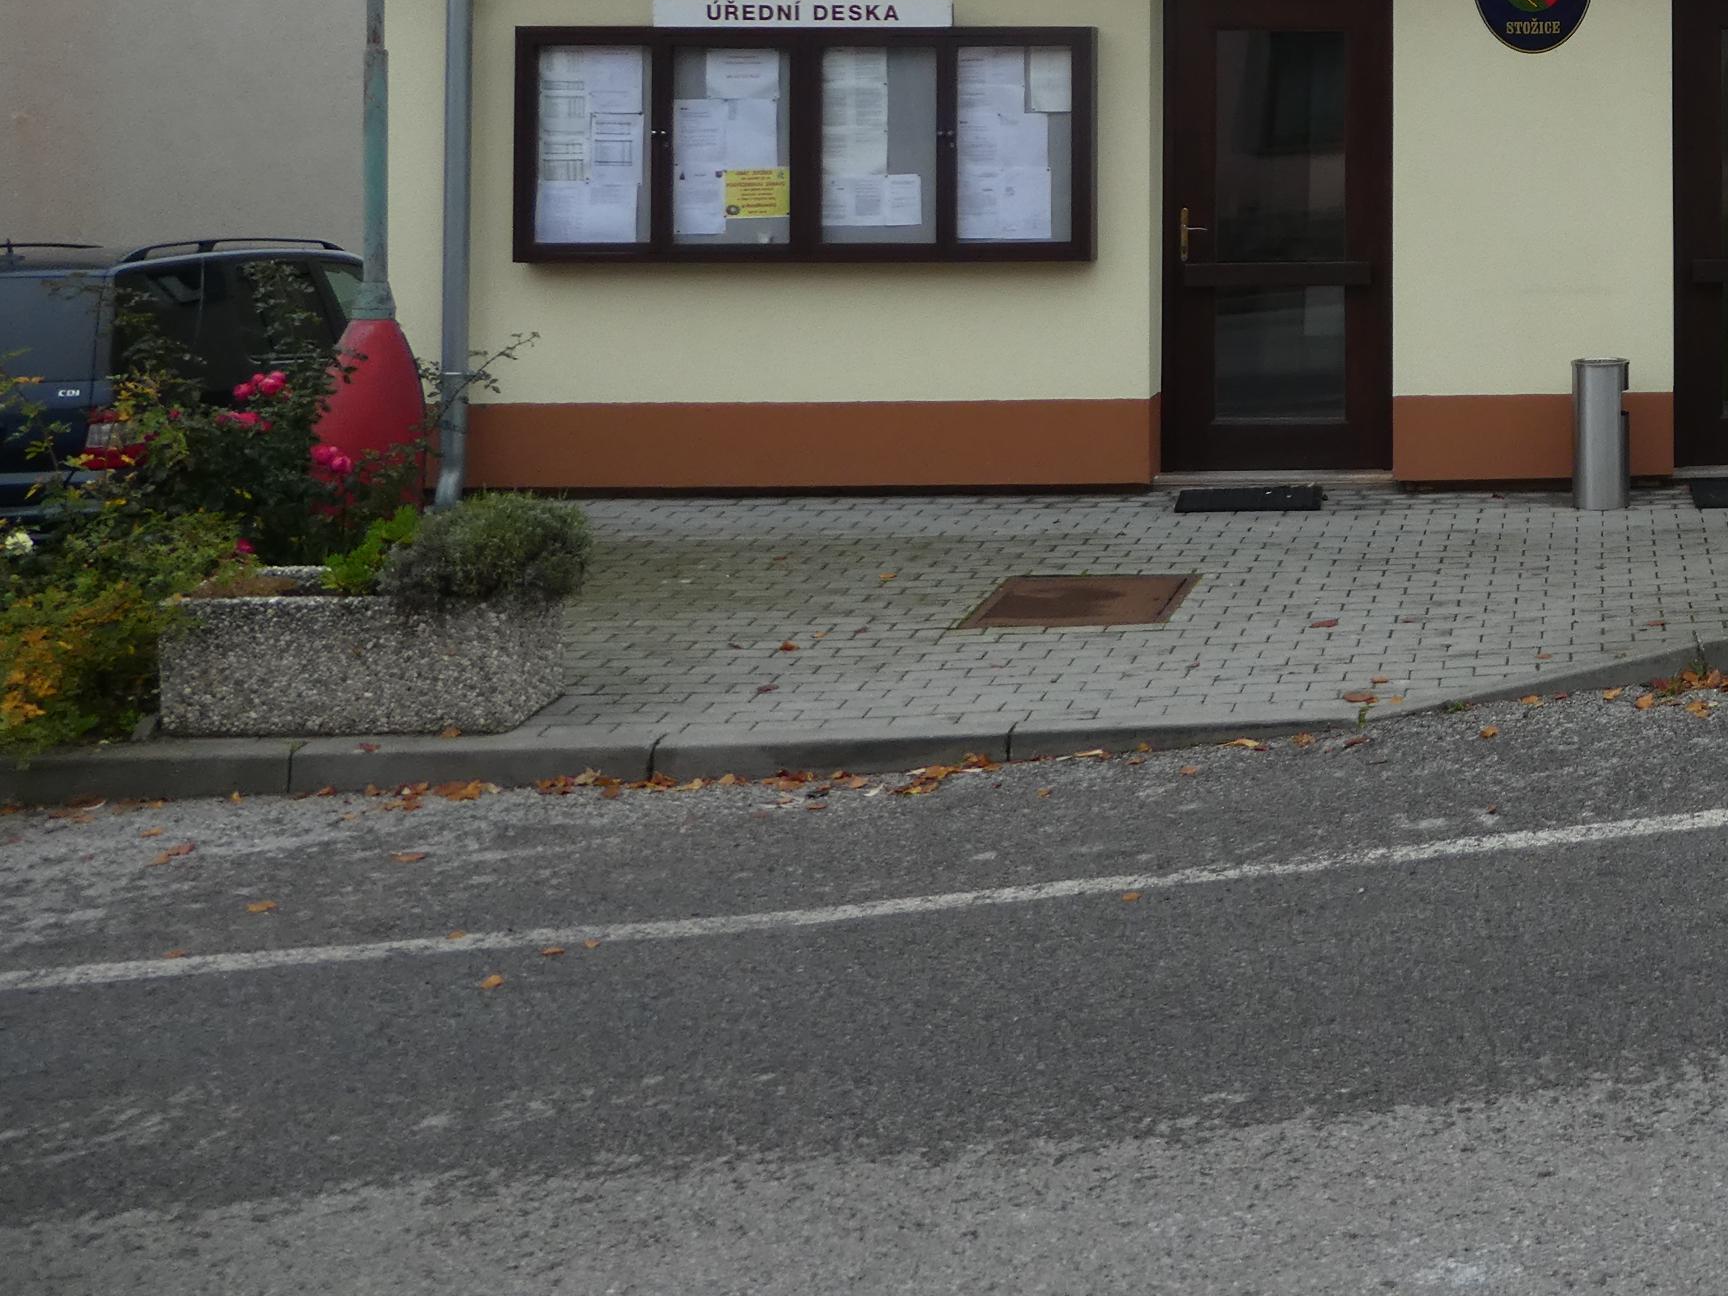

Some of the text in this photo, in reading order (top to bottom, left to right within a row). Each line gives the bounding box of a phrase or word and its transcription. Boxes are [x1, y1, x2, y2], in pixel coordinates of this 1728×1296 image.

[706, 0, 900, 21] ÚŘEDNÍ DESKA
[1506, 17, 1561, 35] STOŽICE
[58, 389, 80, 397] CDI
